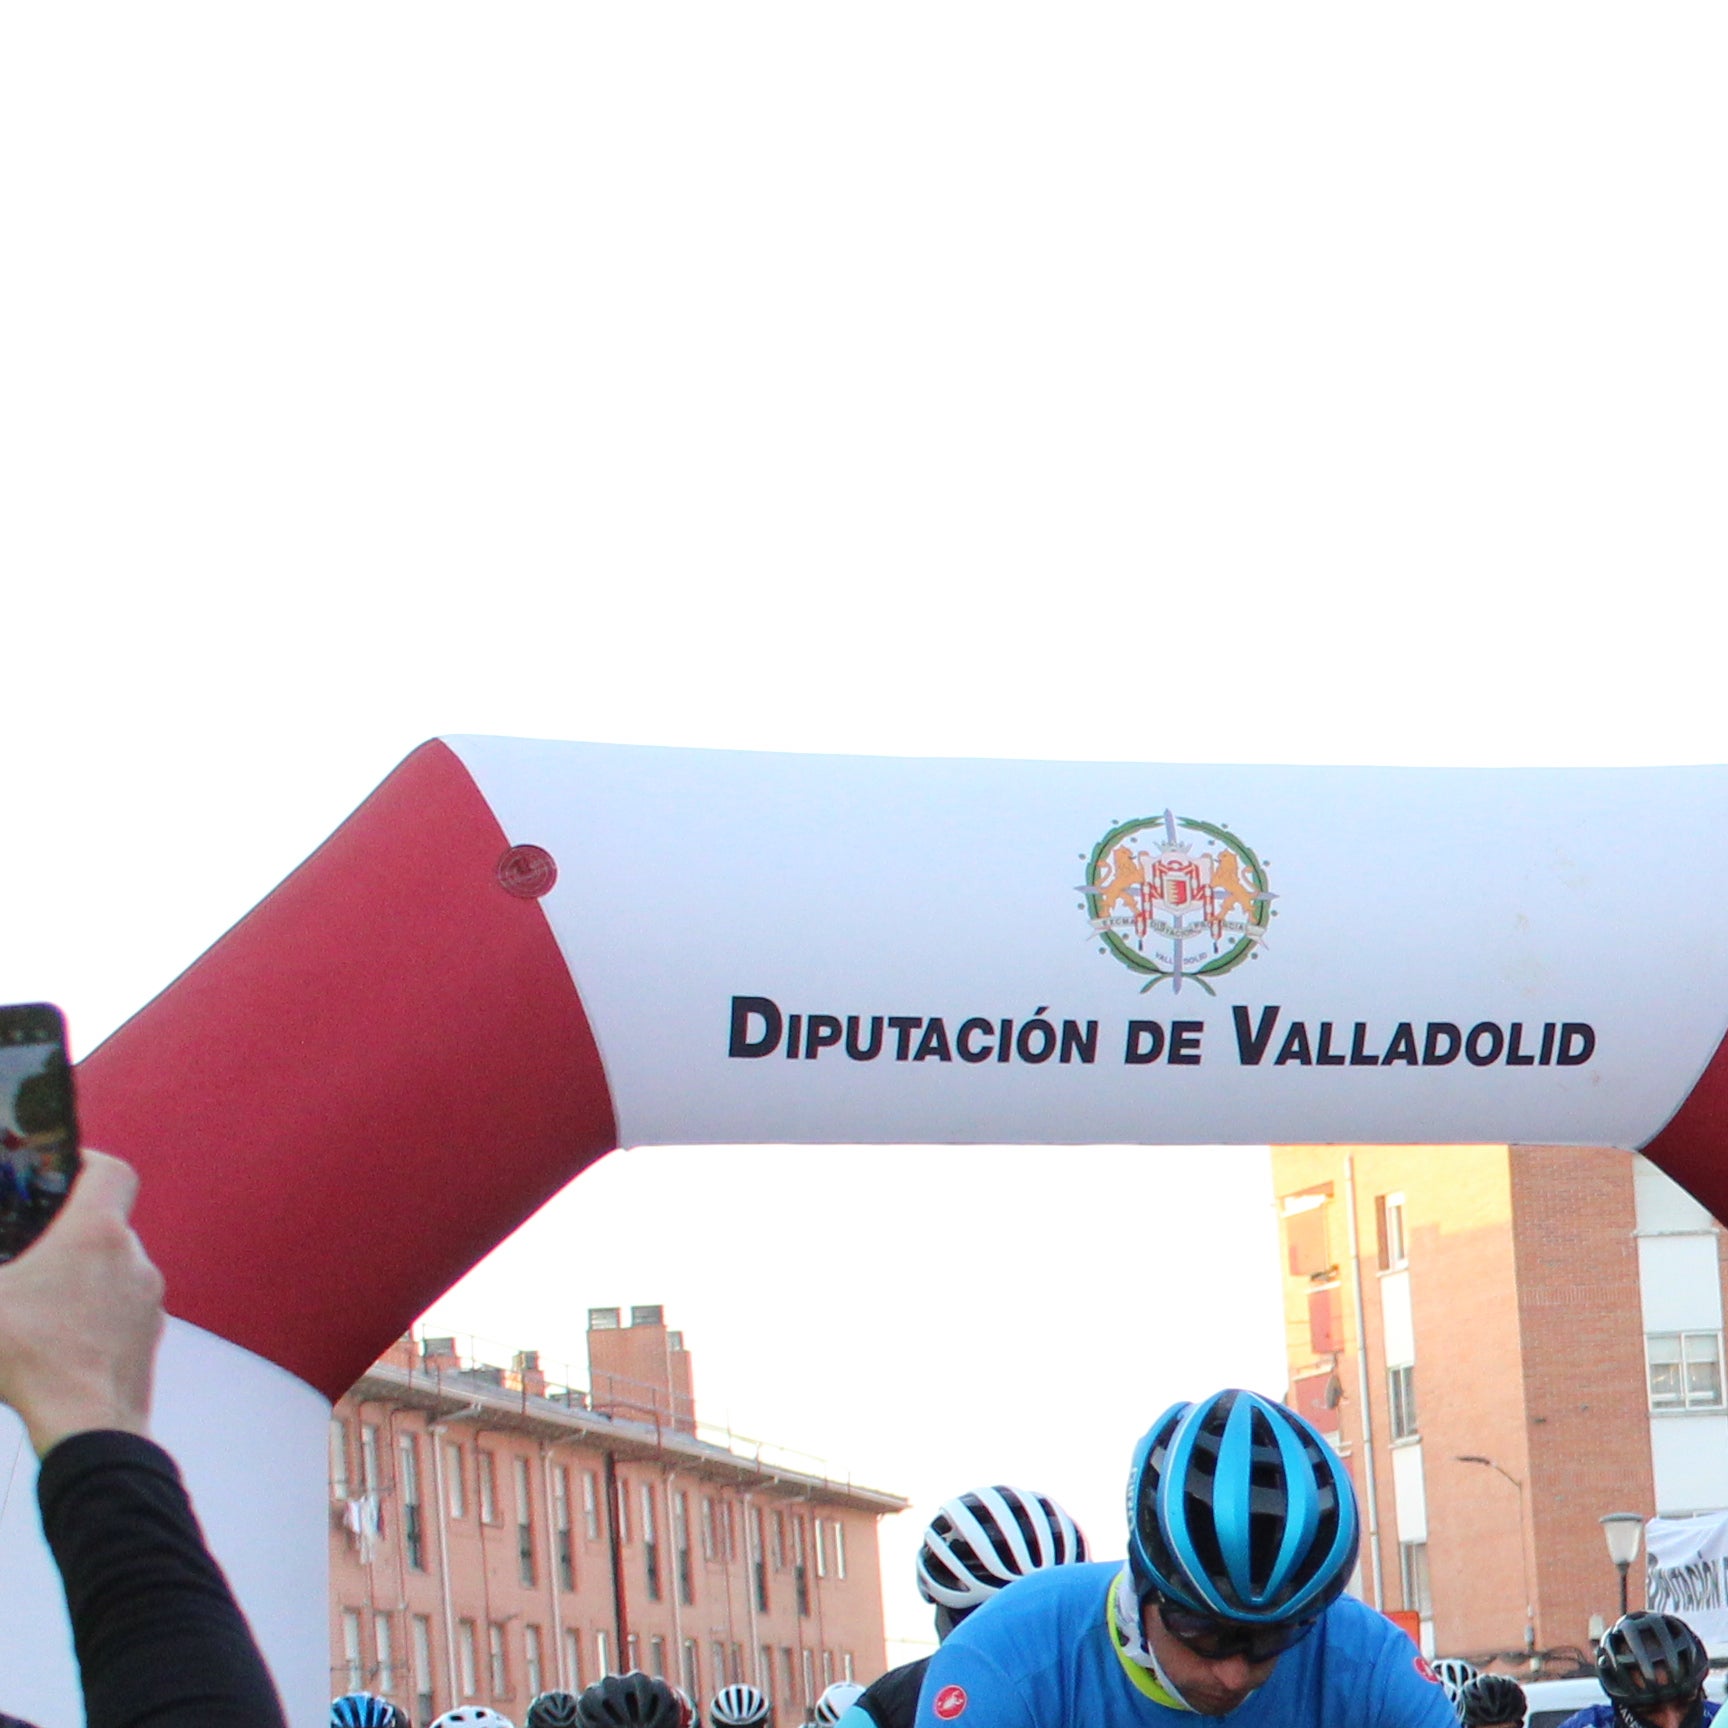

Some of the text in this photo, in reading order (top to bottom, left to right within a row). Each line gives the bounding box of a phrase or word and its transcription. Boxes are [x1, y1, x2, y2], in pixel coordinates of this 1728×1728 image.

[1154, 951, 1208, 965] VALLDOLID
[728, 996, 1597, 1066] DIPUTACIÓN DE VALLADOLID
